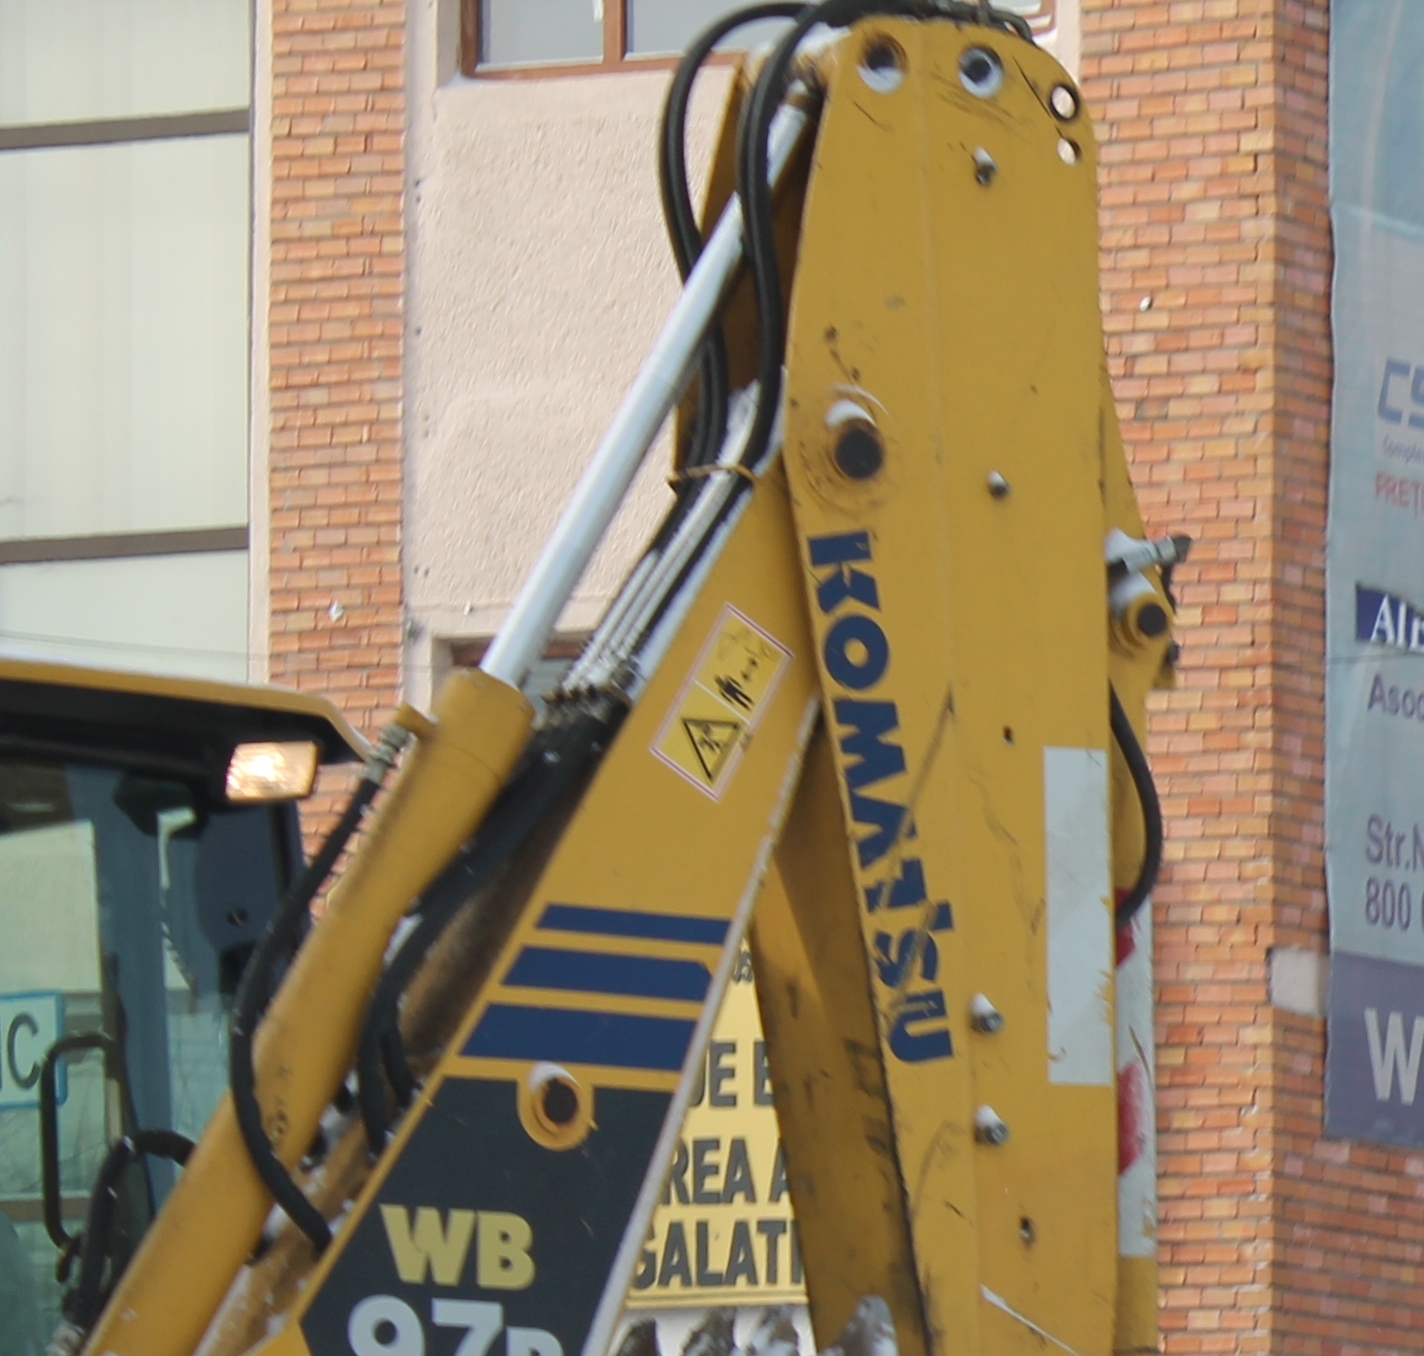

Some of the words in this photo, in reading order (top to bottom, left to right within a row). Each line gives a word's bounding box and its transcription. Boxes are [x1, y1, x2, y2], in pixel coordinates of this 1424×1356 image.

[807, 530, 956, 1065] KOMATSU
[1364, 874, 1413, 932] 800
[379, 1203, 536, 1290] WB
